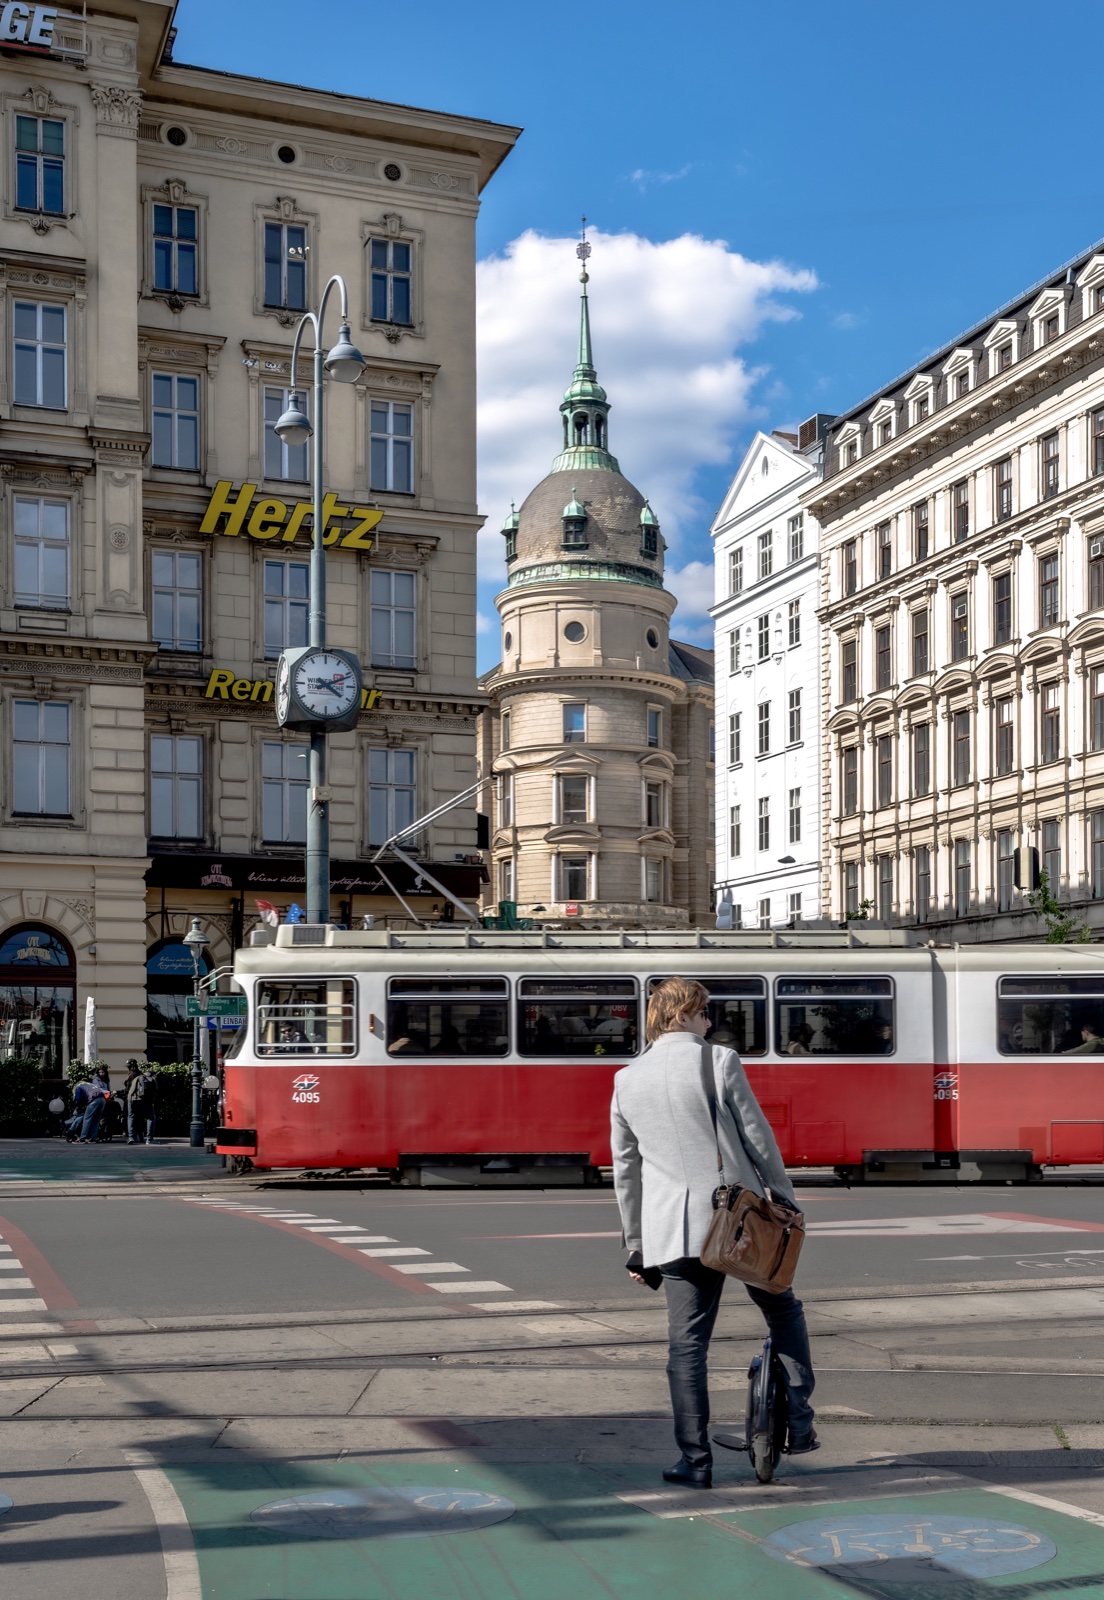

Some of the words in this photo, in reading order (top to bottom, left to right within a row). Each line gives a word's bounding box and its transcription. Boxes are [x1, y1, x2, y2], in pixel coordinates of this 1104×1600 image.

[198, 480, 385, 550] Hertz
[205, 668, 274, 702] Ren
[292, 1092, 320, 1103] 4095
